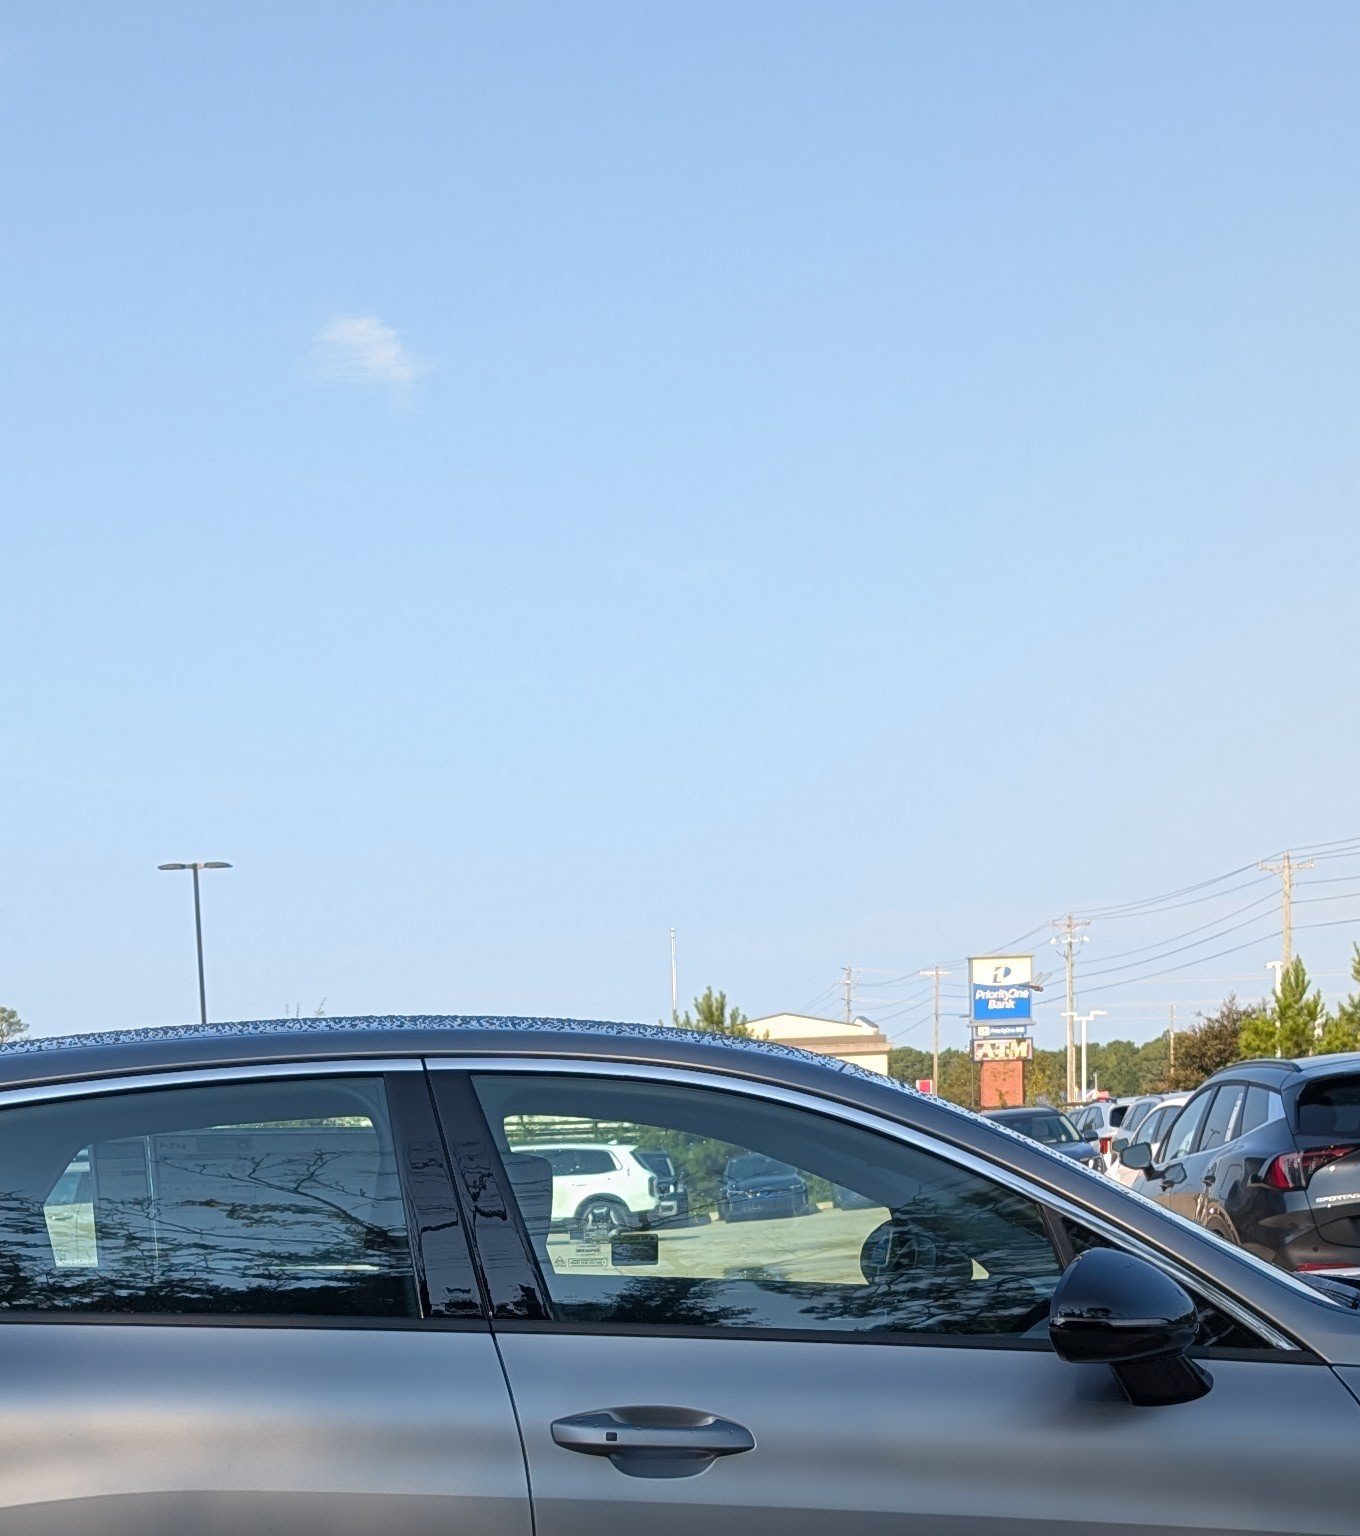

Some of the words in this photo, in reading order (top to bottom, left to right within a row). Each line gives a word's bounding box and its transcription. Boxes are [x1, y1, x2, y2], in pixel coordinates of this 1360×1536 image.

[975, 989, 1029, 1001] PriorityOne
[988, 999, 1016, 1009] Bank
[975, 1041, 1028, 1060] ATM
